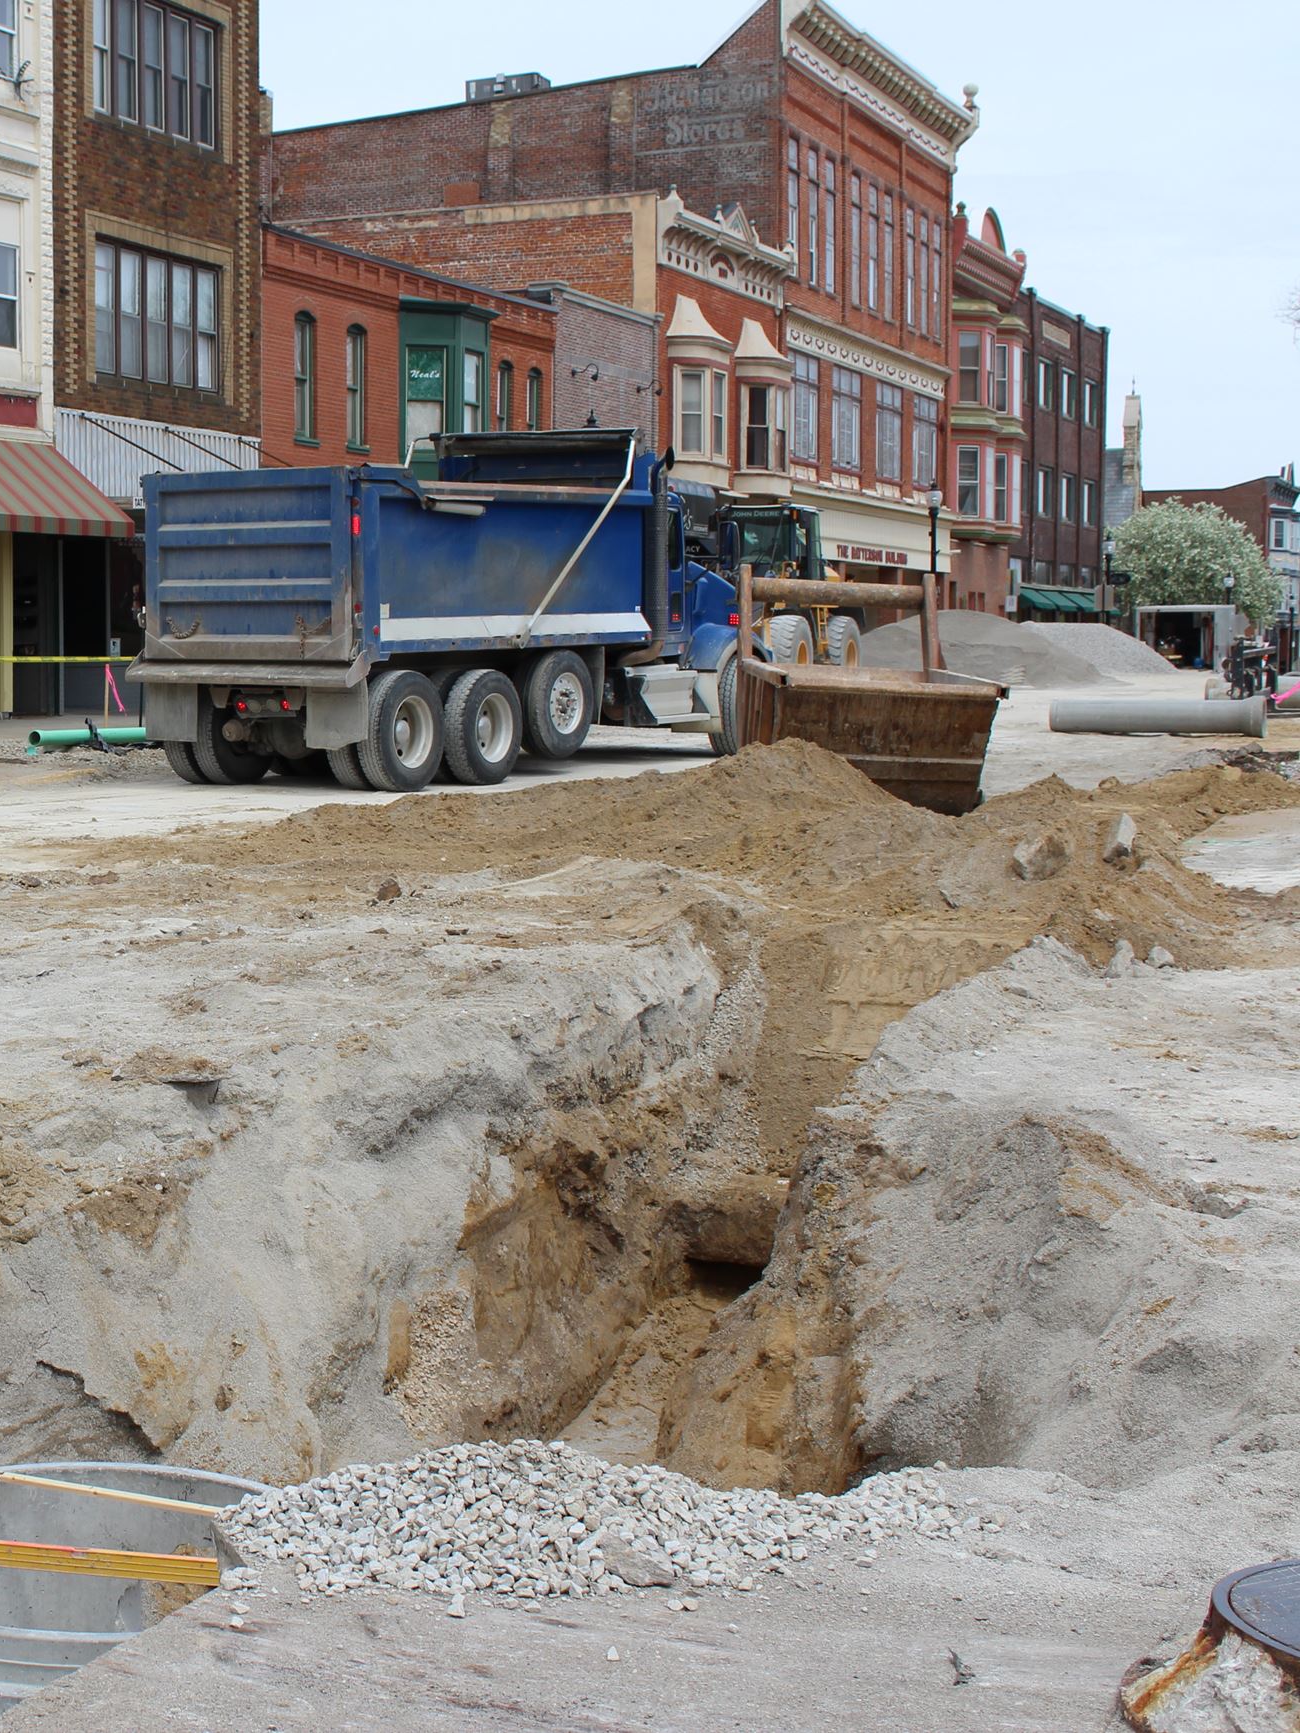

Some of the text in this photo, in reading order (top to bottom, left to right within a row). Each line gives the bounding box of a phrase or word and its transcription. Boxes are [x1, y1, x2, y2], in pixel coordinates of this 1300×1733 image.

[410, 369, 440, 379] Neal's
[732, 510, 780, 518] JOHN DEERE
[836, 544, 849, 559] THE
